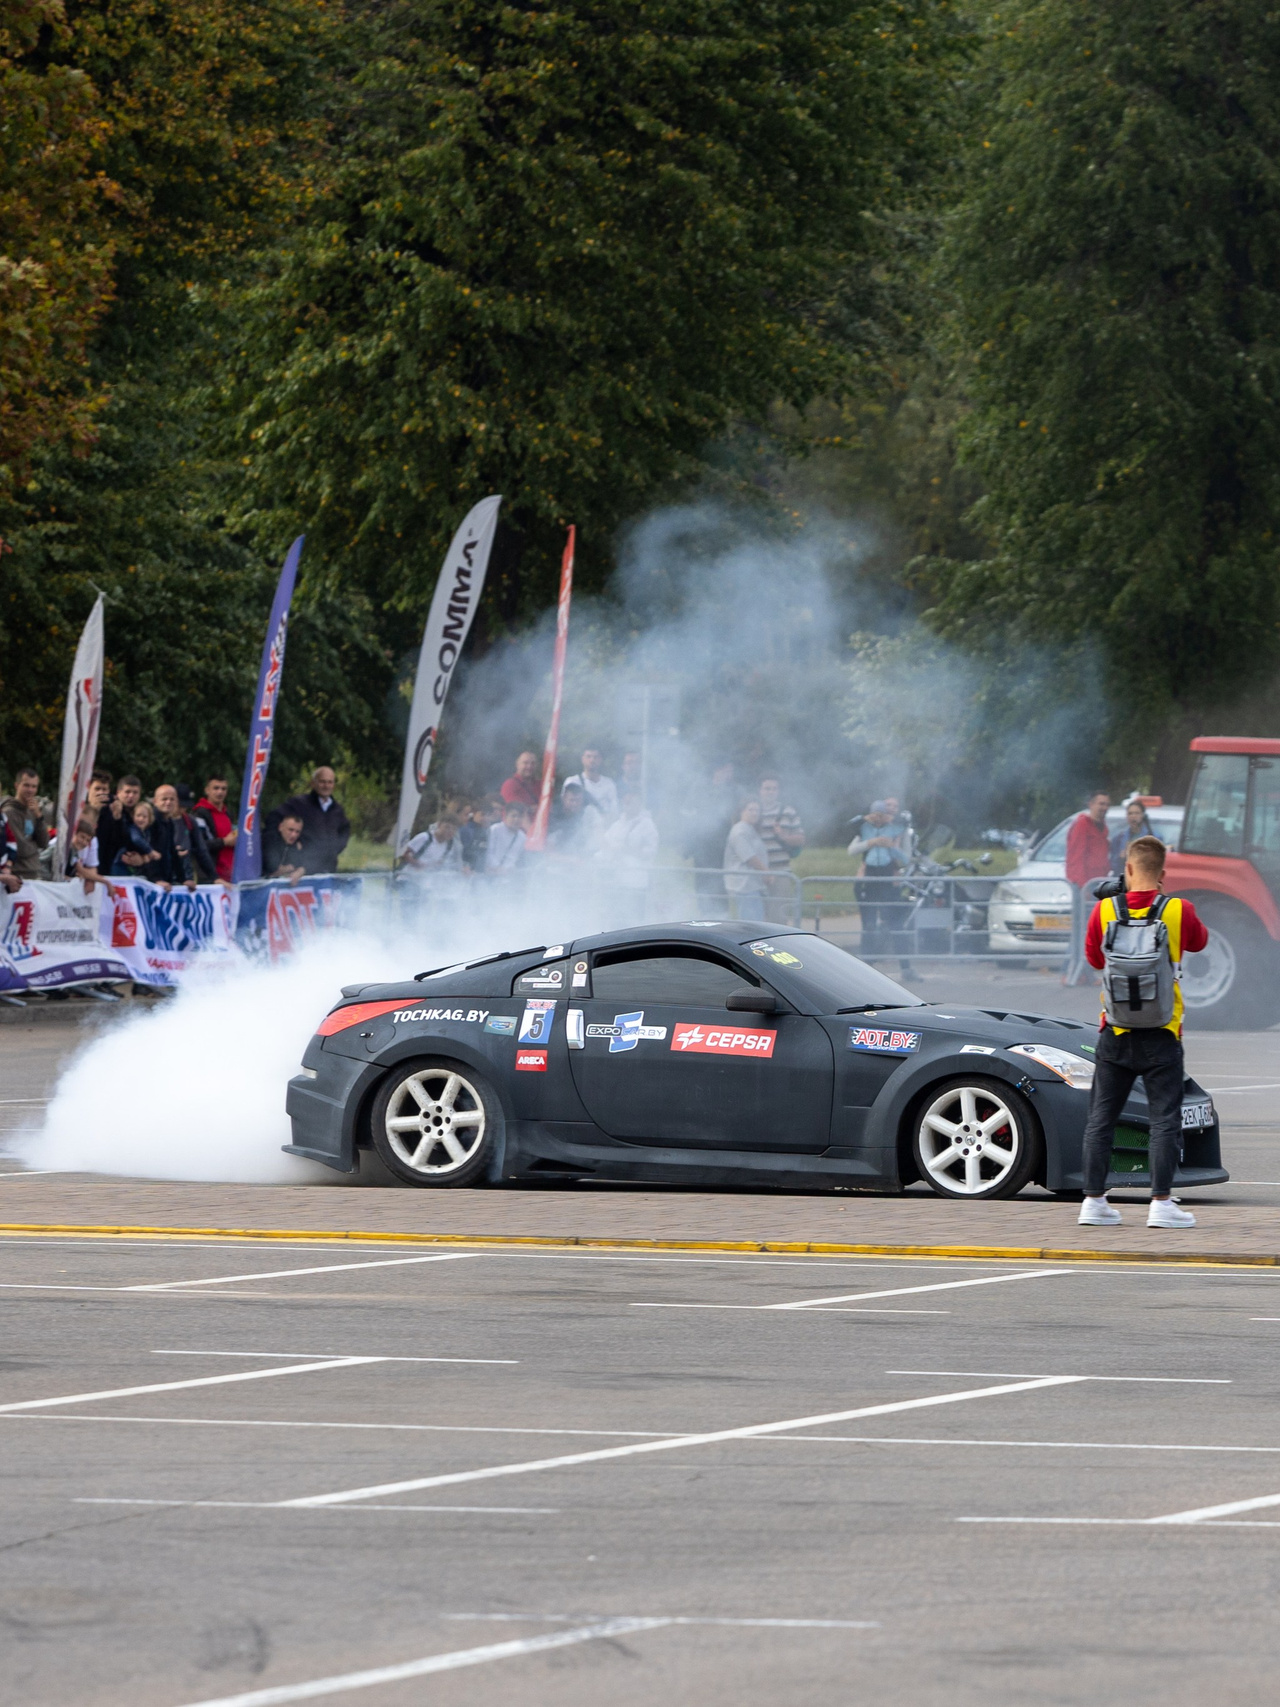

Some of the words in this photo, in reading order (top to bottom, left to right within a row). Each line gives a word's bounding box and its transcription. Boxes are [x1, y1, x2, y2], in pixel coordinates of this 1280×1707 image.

[433, 540, 478, 705] COMMA
[393, 1009, 490, 1023] TOCHKAG.BY
[529, 1013, 546, 1039] 5
[705, 1031, 772, 1051] CEPSA
[855, 1029, 913, 1049] ADT.BY
[518, 1056, 545, 1065] ARECA
